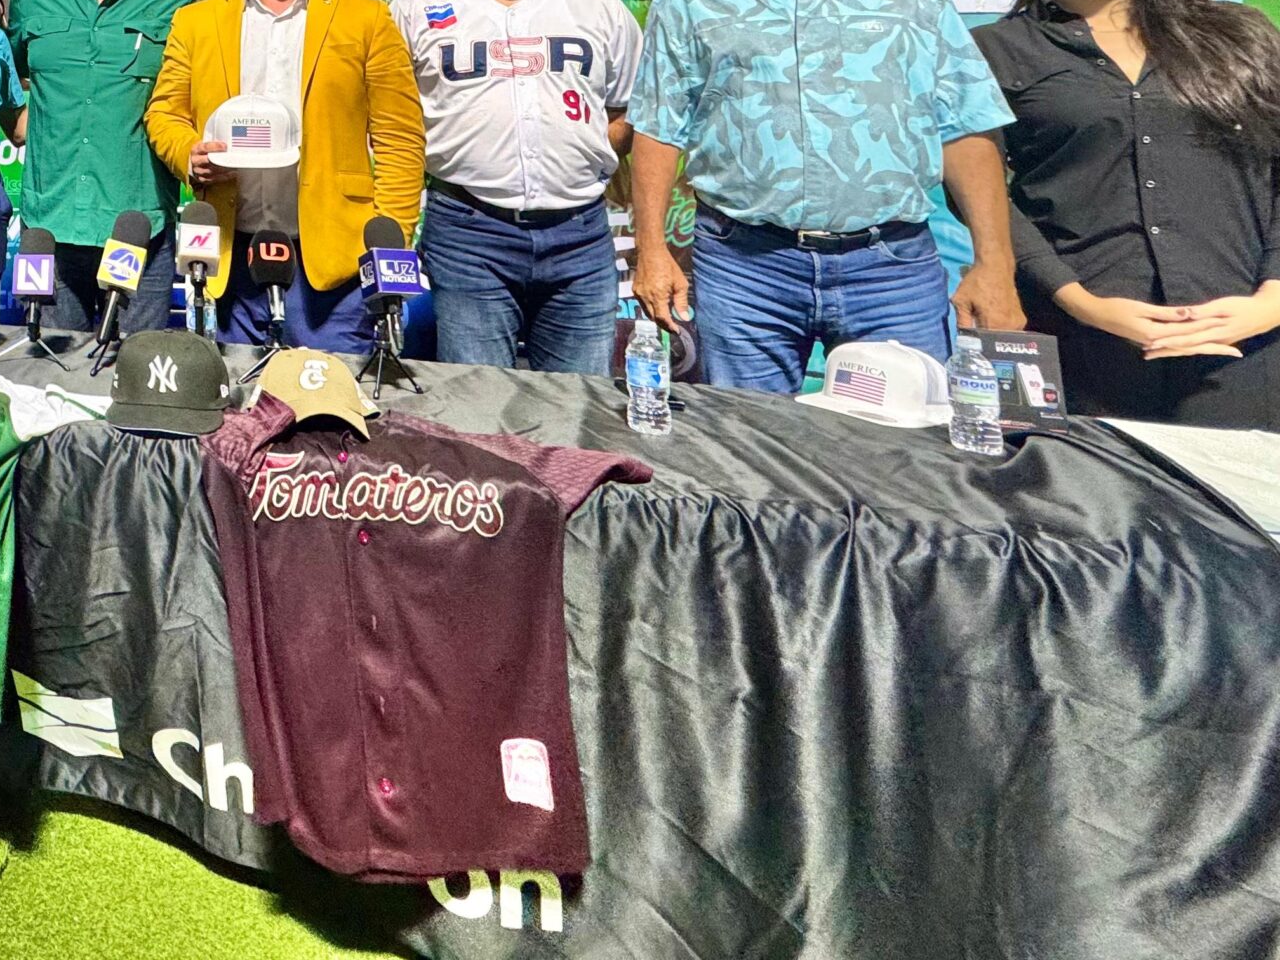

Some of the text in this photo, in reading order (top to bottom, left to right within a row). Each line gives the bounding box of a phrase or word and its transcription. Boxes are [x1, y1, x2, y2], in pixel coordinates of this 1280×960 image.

[438, 35, 594, 82] USA
[232, 118, 271, 126] AMERICA
[379, 259, 417, 276] LUZ
[381, 275, 418, 284] NOTICIAS
[995, 347, 1039, 355] RADAR
[147, 354, 178, 393] NY
[837, 360, 887, 379] AMERICA
[248, 451, 504, 537] Tomateros
